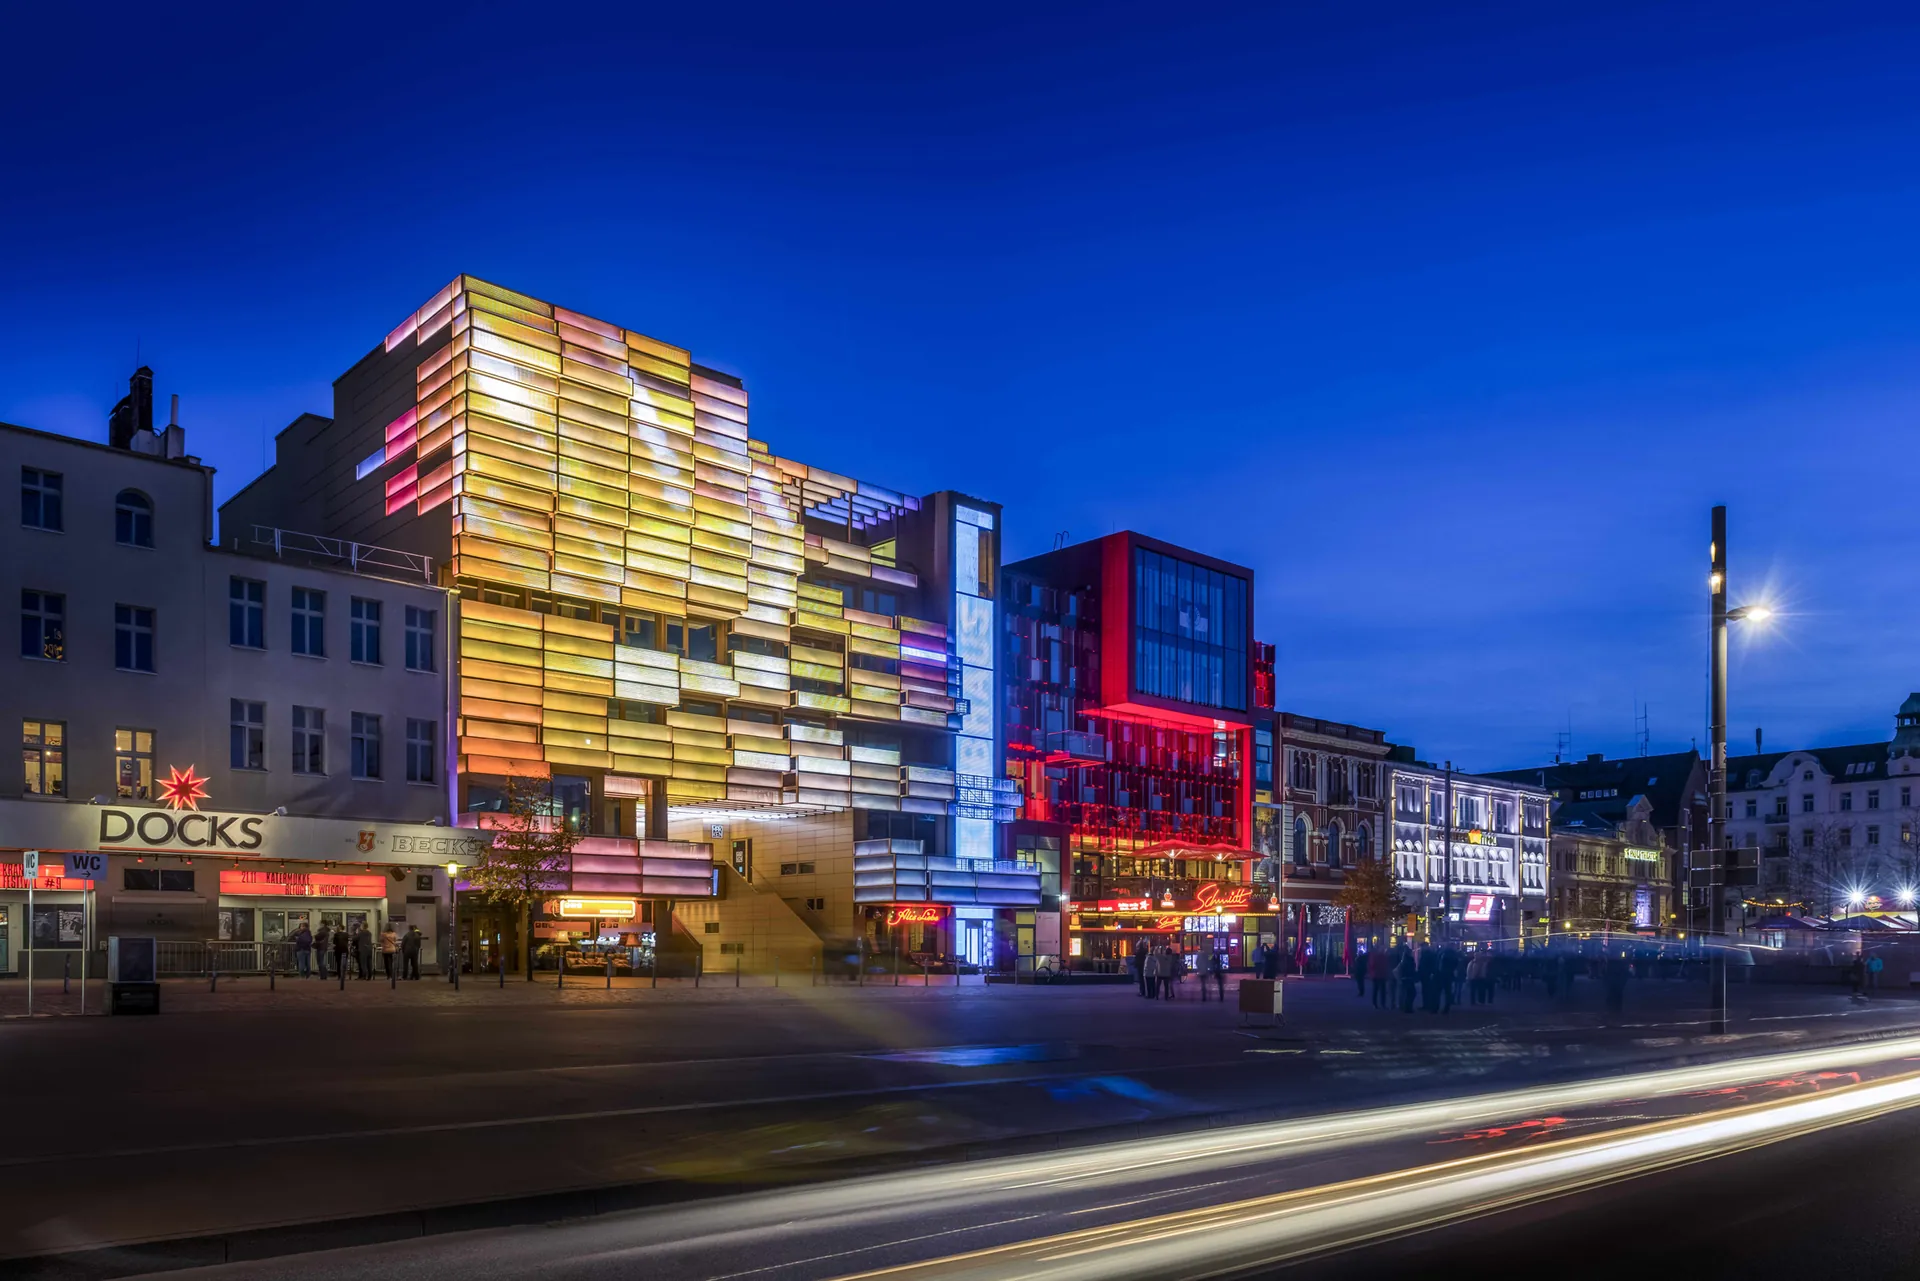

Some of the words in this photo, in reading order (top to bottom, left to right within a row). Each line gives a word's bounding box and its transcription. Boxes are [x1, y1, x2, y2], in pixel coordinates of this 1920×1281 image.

[99, 809, 264, 850] DOCKS
[25, 853, 35, 868] WC
[72, 855, 101, 870] WC
[1192, 882, 1253, 913] Schmidt
